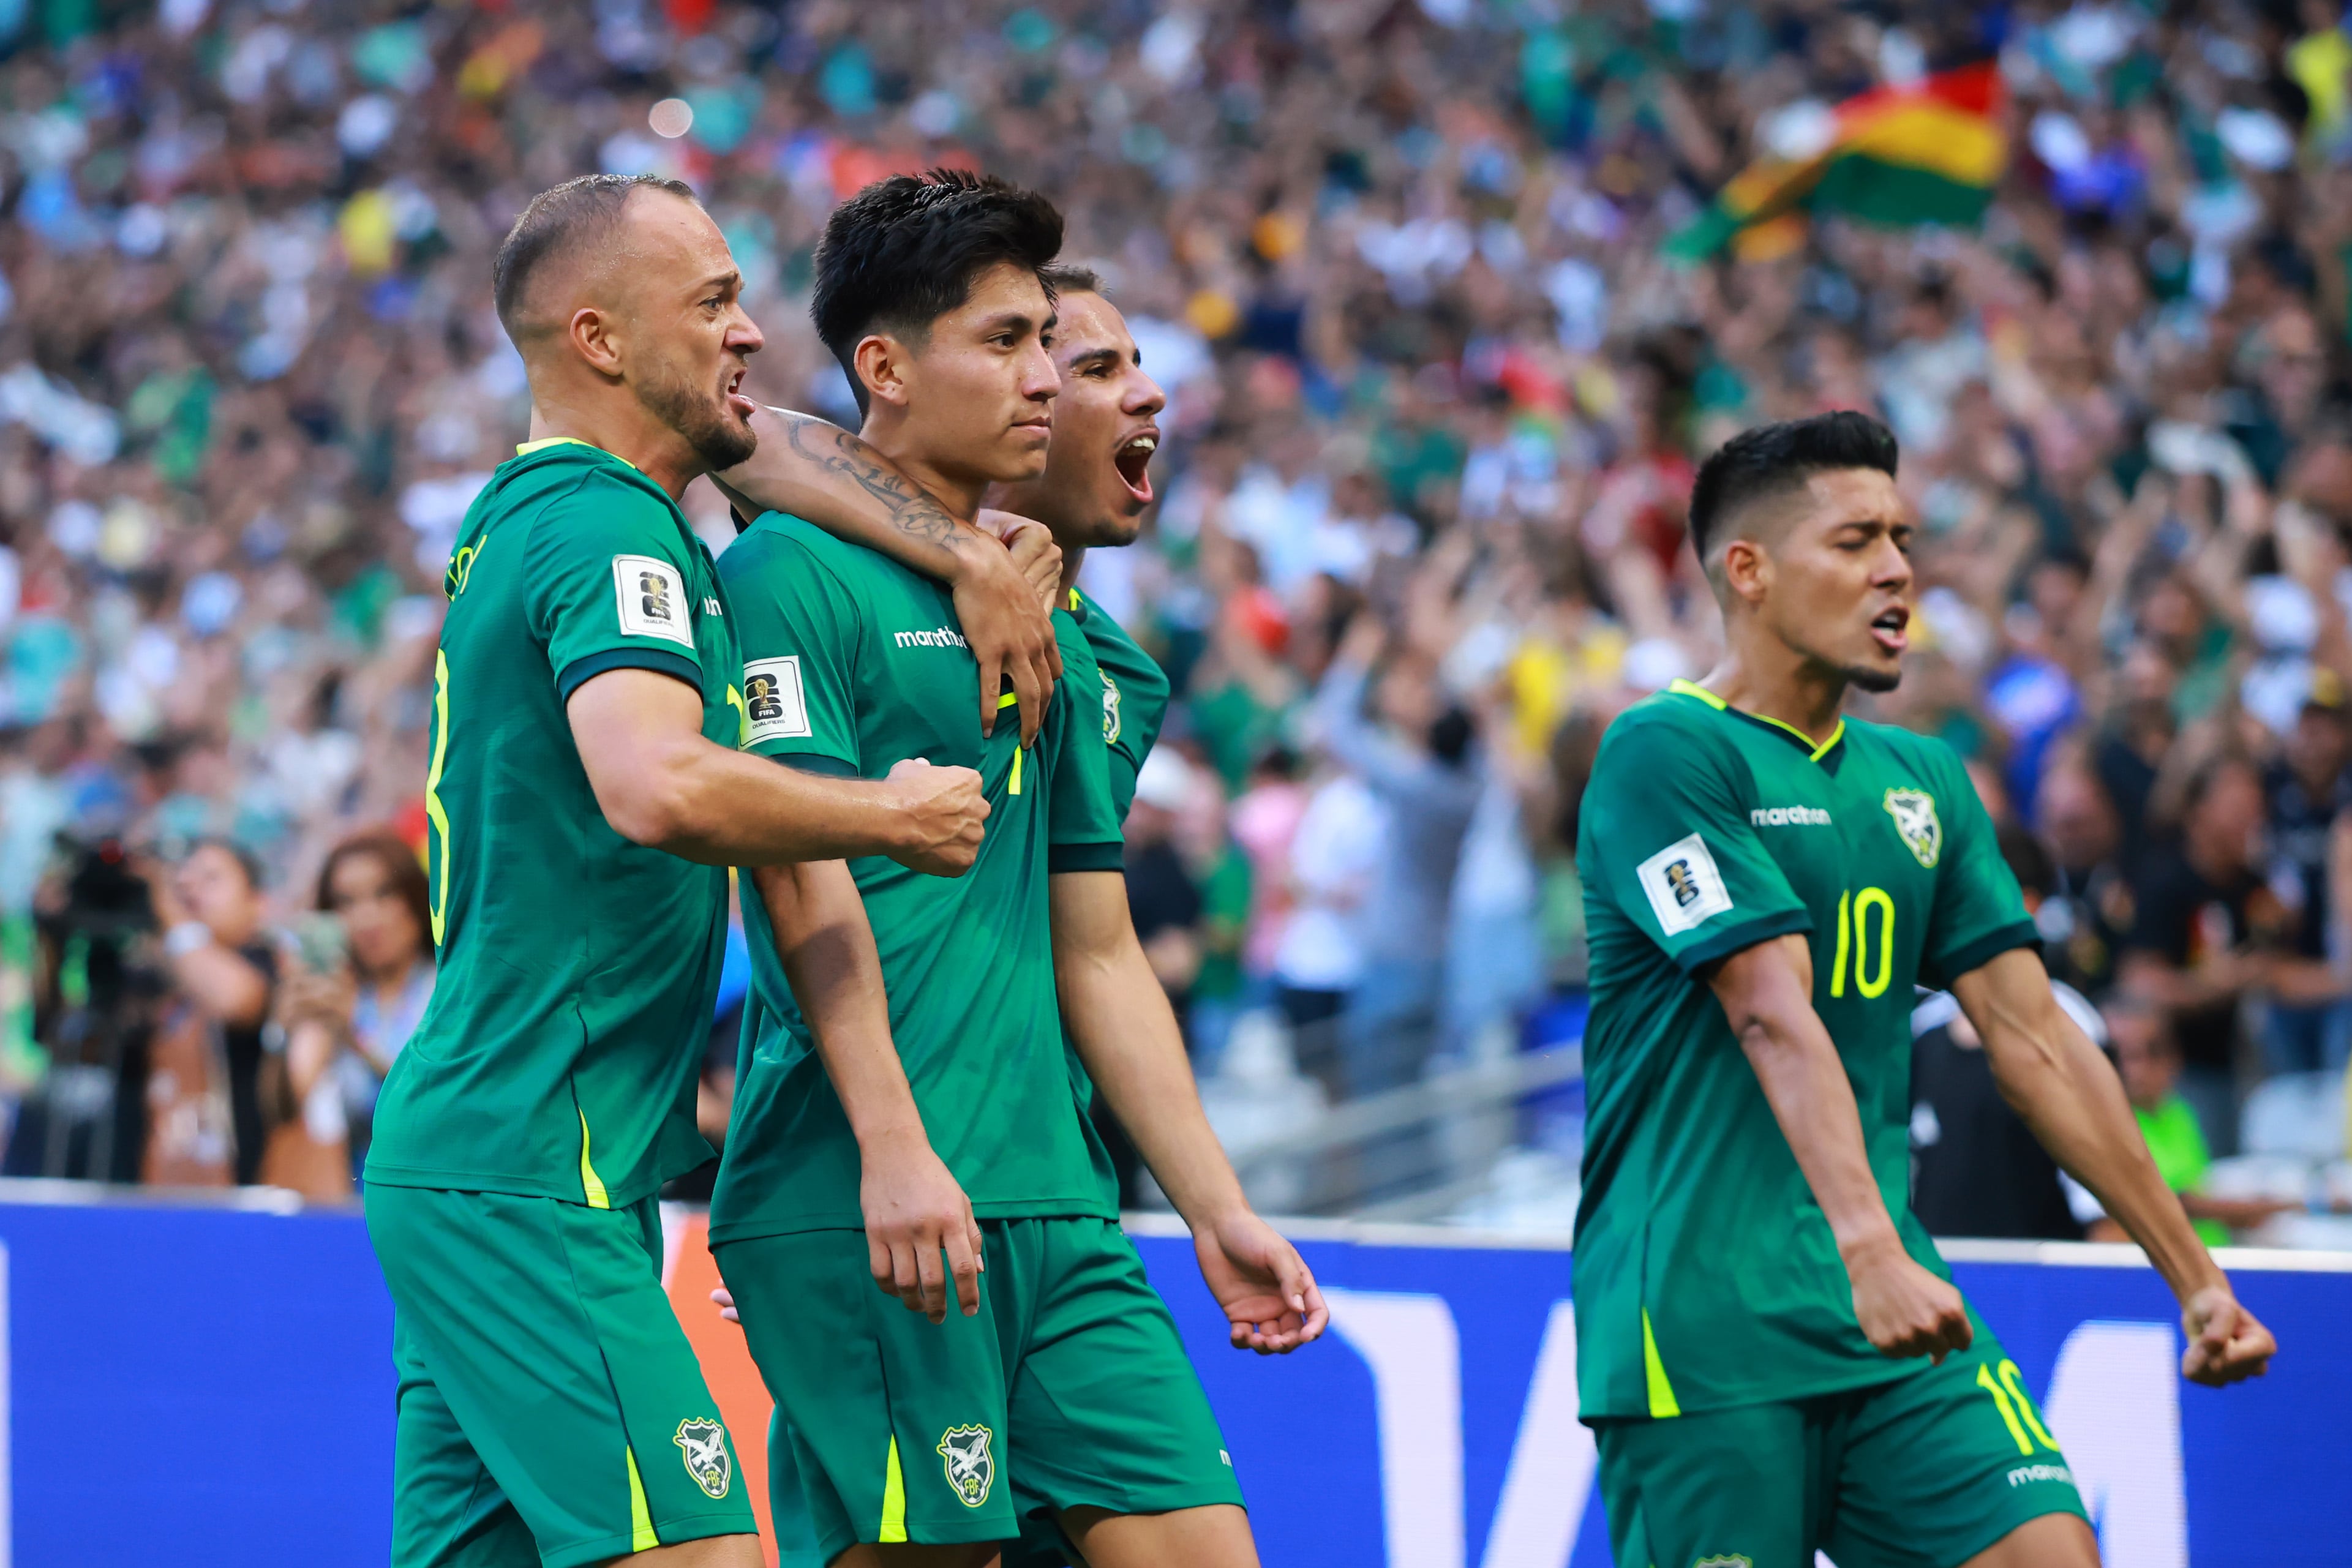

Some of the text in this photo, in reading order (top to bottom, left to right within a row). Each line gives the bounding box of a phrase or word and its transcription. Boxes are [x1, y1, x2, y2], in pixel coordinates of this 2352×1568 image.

[758, 708, 775, 717] FIFA
[752, 719, 786, 729] QUALIFIERS
[1830, 887, 1895, 999] 10
[705, 1470, 720, 1487] FBF
[964, 1478, 980, 1496] FBF
